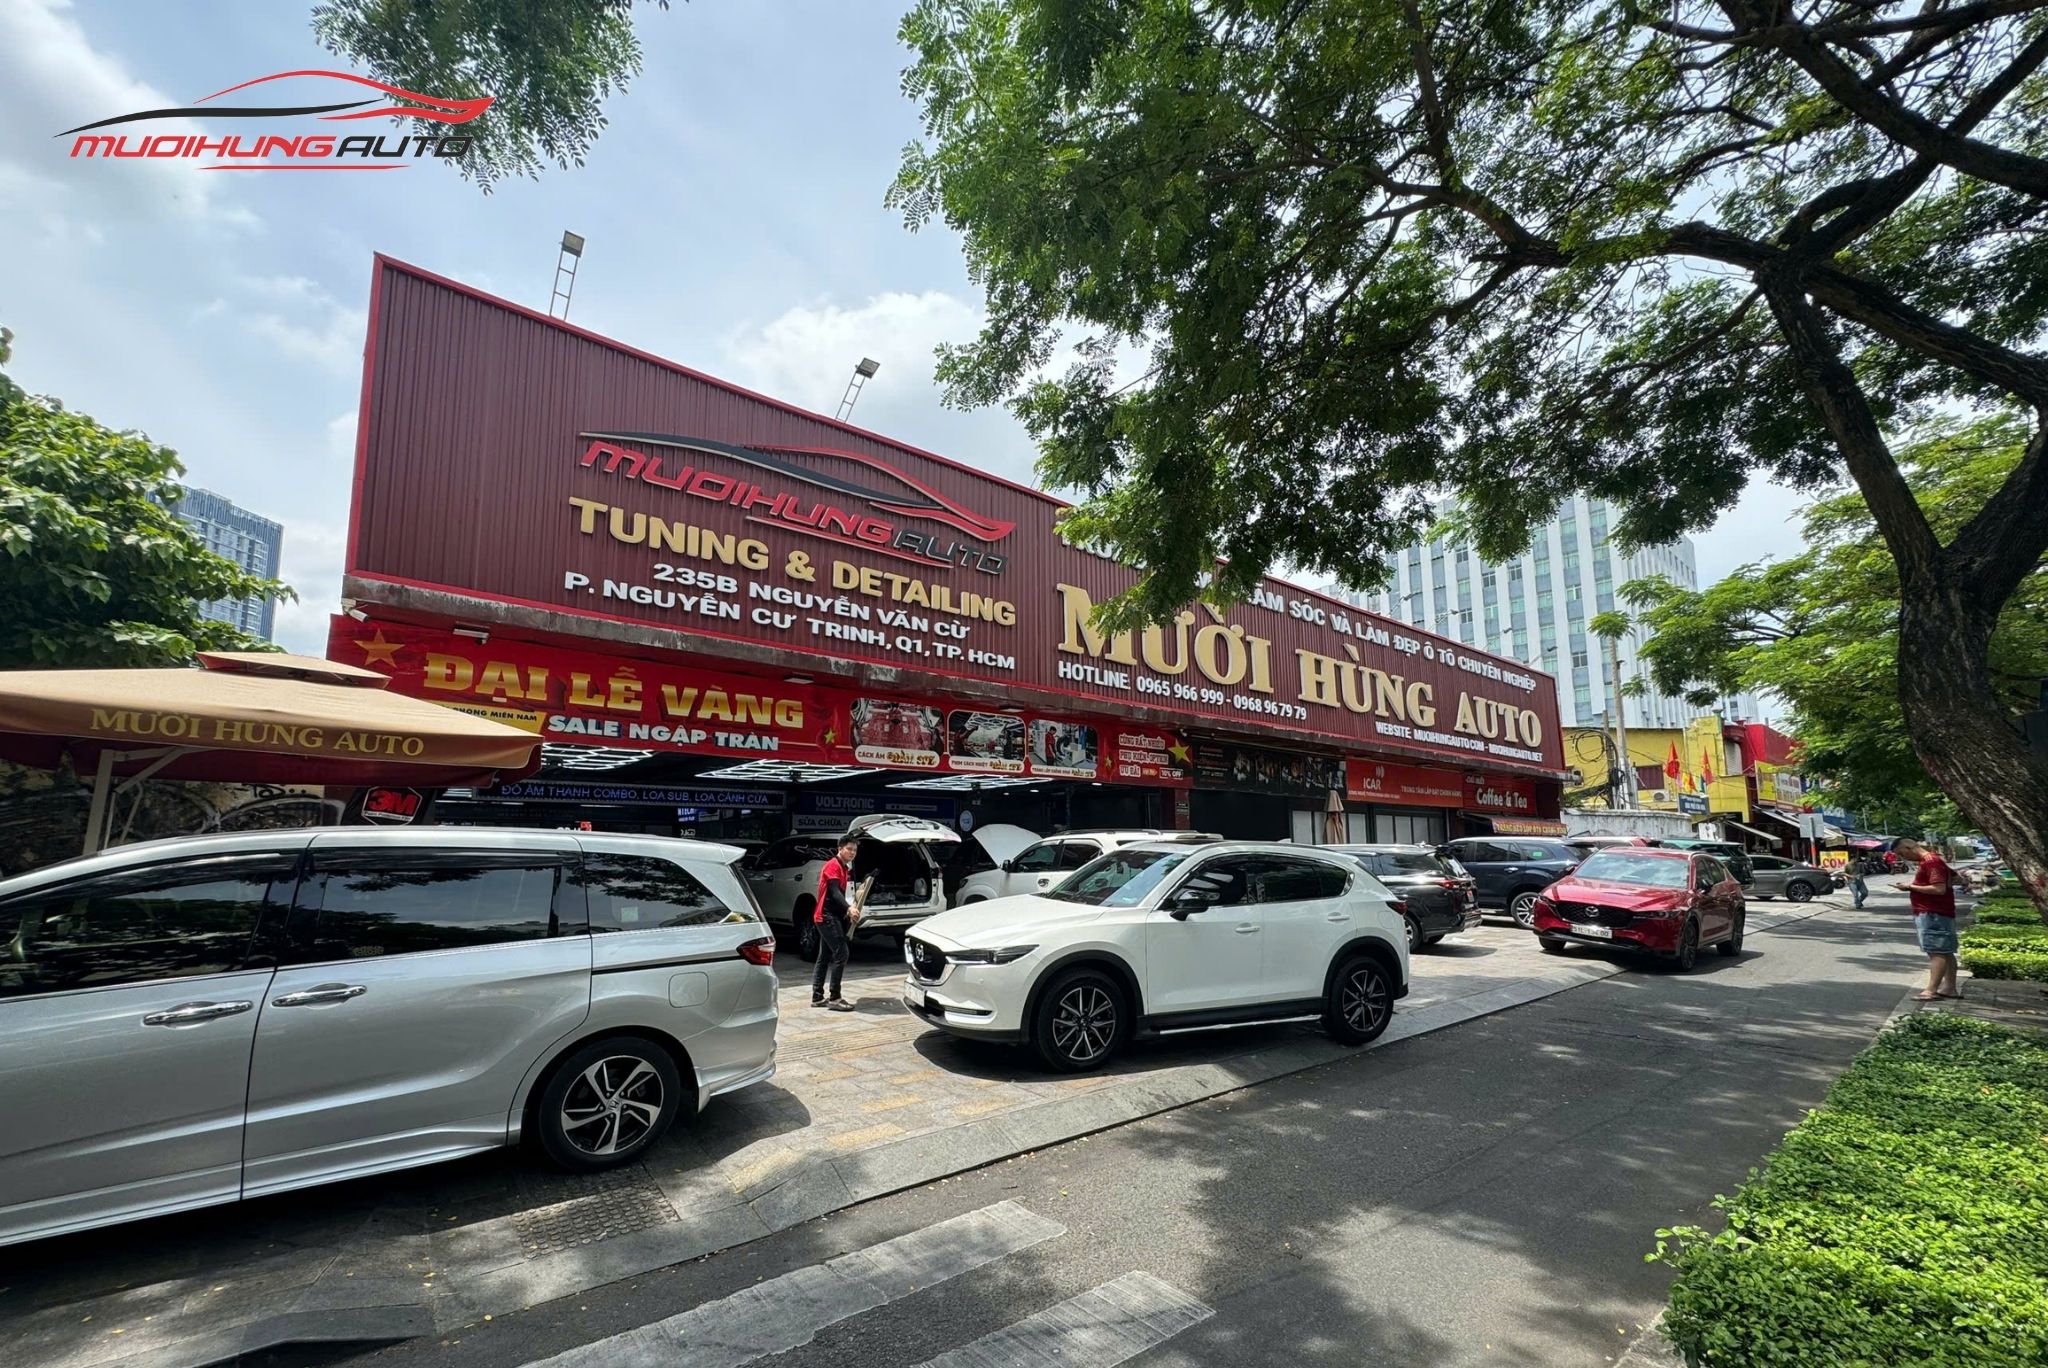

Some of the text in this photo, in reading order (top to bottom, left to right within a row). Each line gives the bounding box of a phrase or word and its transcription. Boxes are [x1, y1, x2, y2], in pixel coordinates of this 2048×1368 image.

[569, 496, 1016, 626] TUNING & DETAILING
[564, 571, 594, 594] P.
[603, 579, 741, 620] NGUYỄN
[751, 608, 798, 629] CƯ
[968, 649, 1015, 670] HCM
[653, 563, 970, 639] 235B NGUYỄN VĂN CỪ
[1247, 583, 1537, 694] ĂM SÓC VÀ LÀM ĐẸP Ô TÔ CHUYÊN NGHIỆP
[1057, 583, 1542, 748] MƯỜI HÙNG AUTO
[423, 652, 804, 728] ĐẠI LỄ VÀNG
[1136, 676, 1171, 696] 0965
[1173, 683, 1198, 701] 966
[1200, 688, 1224, 706] 999
[1233, 694, 1262, 714] 0968
[1264, 701, 1278, 715] 96
[1279, 703, 1293, 718] 79
[1294, 705, 1307, 720] 79
[516, 713, 538, 723] NAM
[548, 715, 779, 750] SALE NGẬP TRÀN
[333, 731, 424, 756] AUTO
[367, 790, 418, 816] 3M
[1363, 777, 1381, 790] ICAR
[1477, 787, 1504, 807] Coffee
[1513, 792, 1528, 809] Tea
